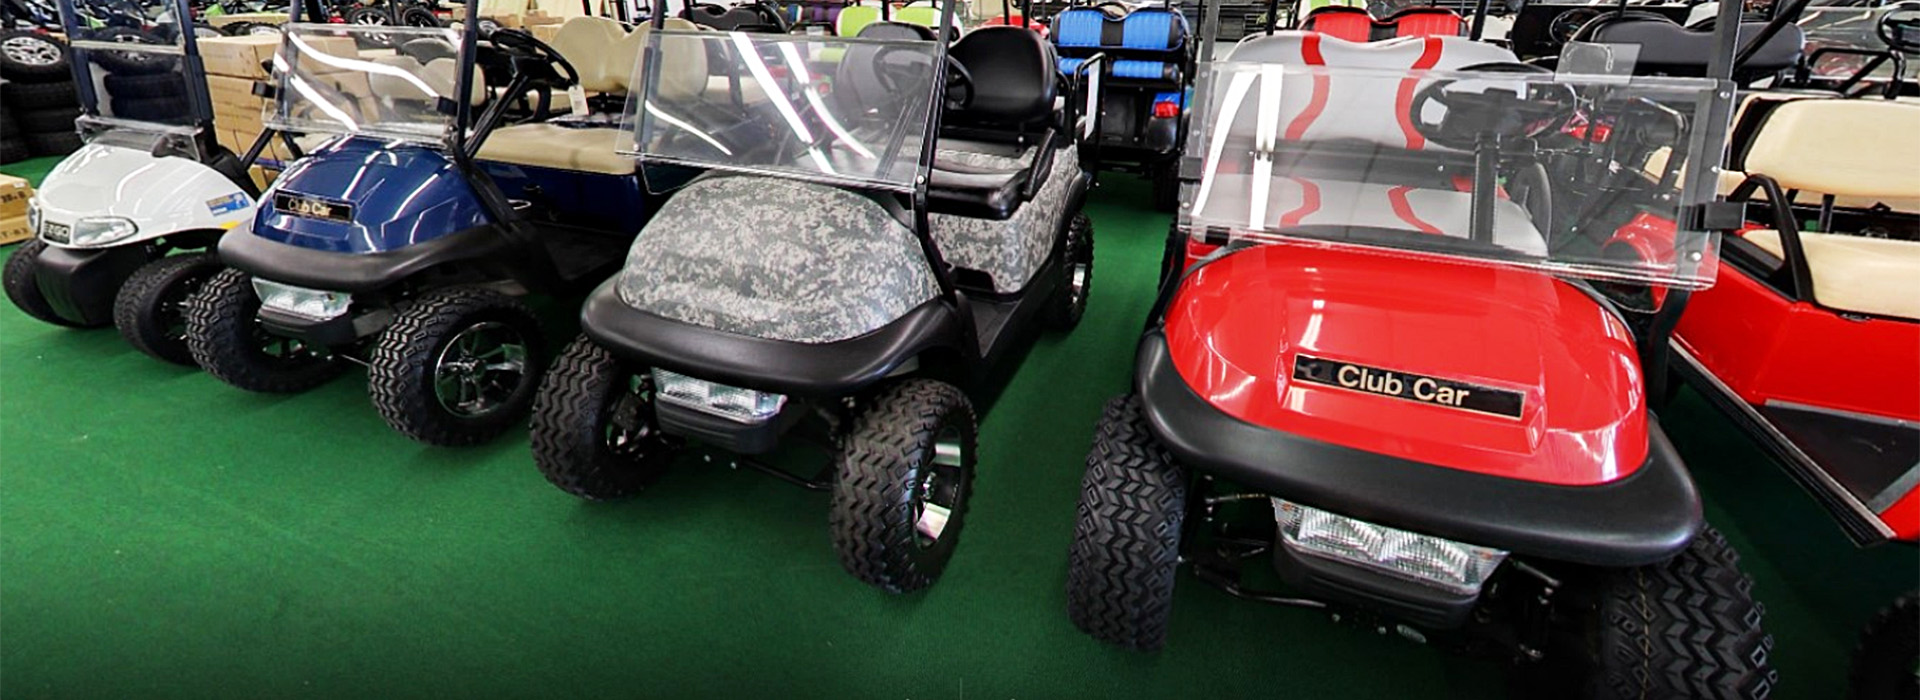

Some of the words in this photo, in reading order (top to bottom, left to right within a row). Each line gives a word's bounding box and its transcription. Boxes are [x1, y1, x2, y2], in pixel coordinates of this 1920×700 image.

[288, 199, 310, 213] Club
[312, 202, 332, 216] Car
[1337, 365, 1403, 396] Club
[1413, 377, 1470, 406] Car
